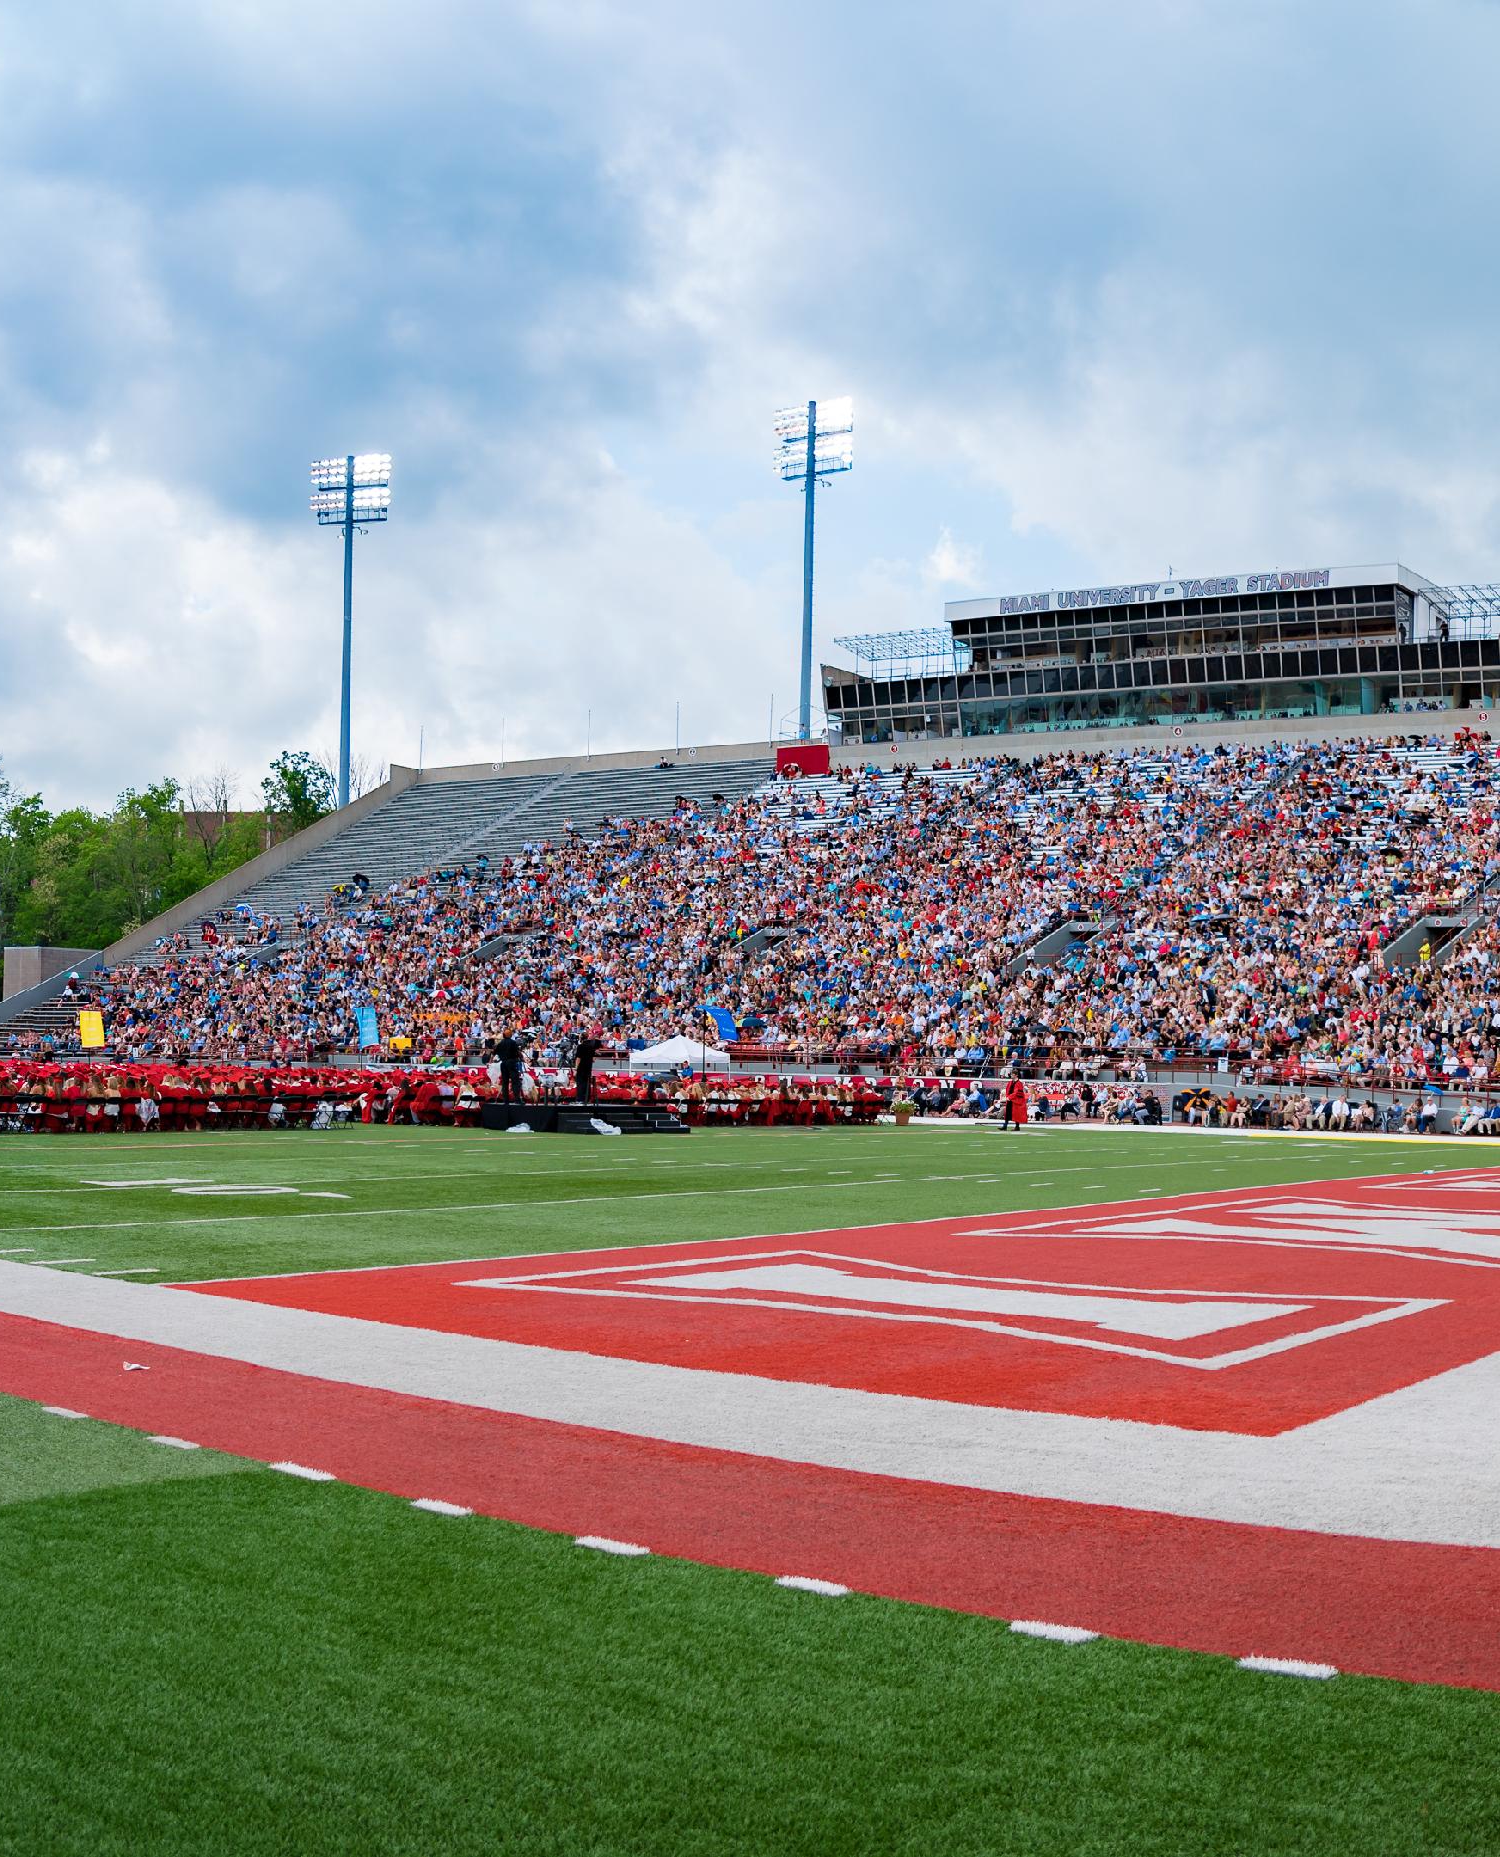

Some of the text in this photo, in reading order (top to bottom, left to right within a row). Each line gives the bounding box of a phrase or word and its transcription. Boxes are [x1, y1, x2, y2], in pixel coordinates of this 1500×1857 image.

[1000, 594, 1050, 614] MIAMI
[1056, 584, 1161, 609] UNIVERSITY
[1179, 576, 1238, 598] YAGER
[1246, 570, 1330, 592] STADIUM
